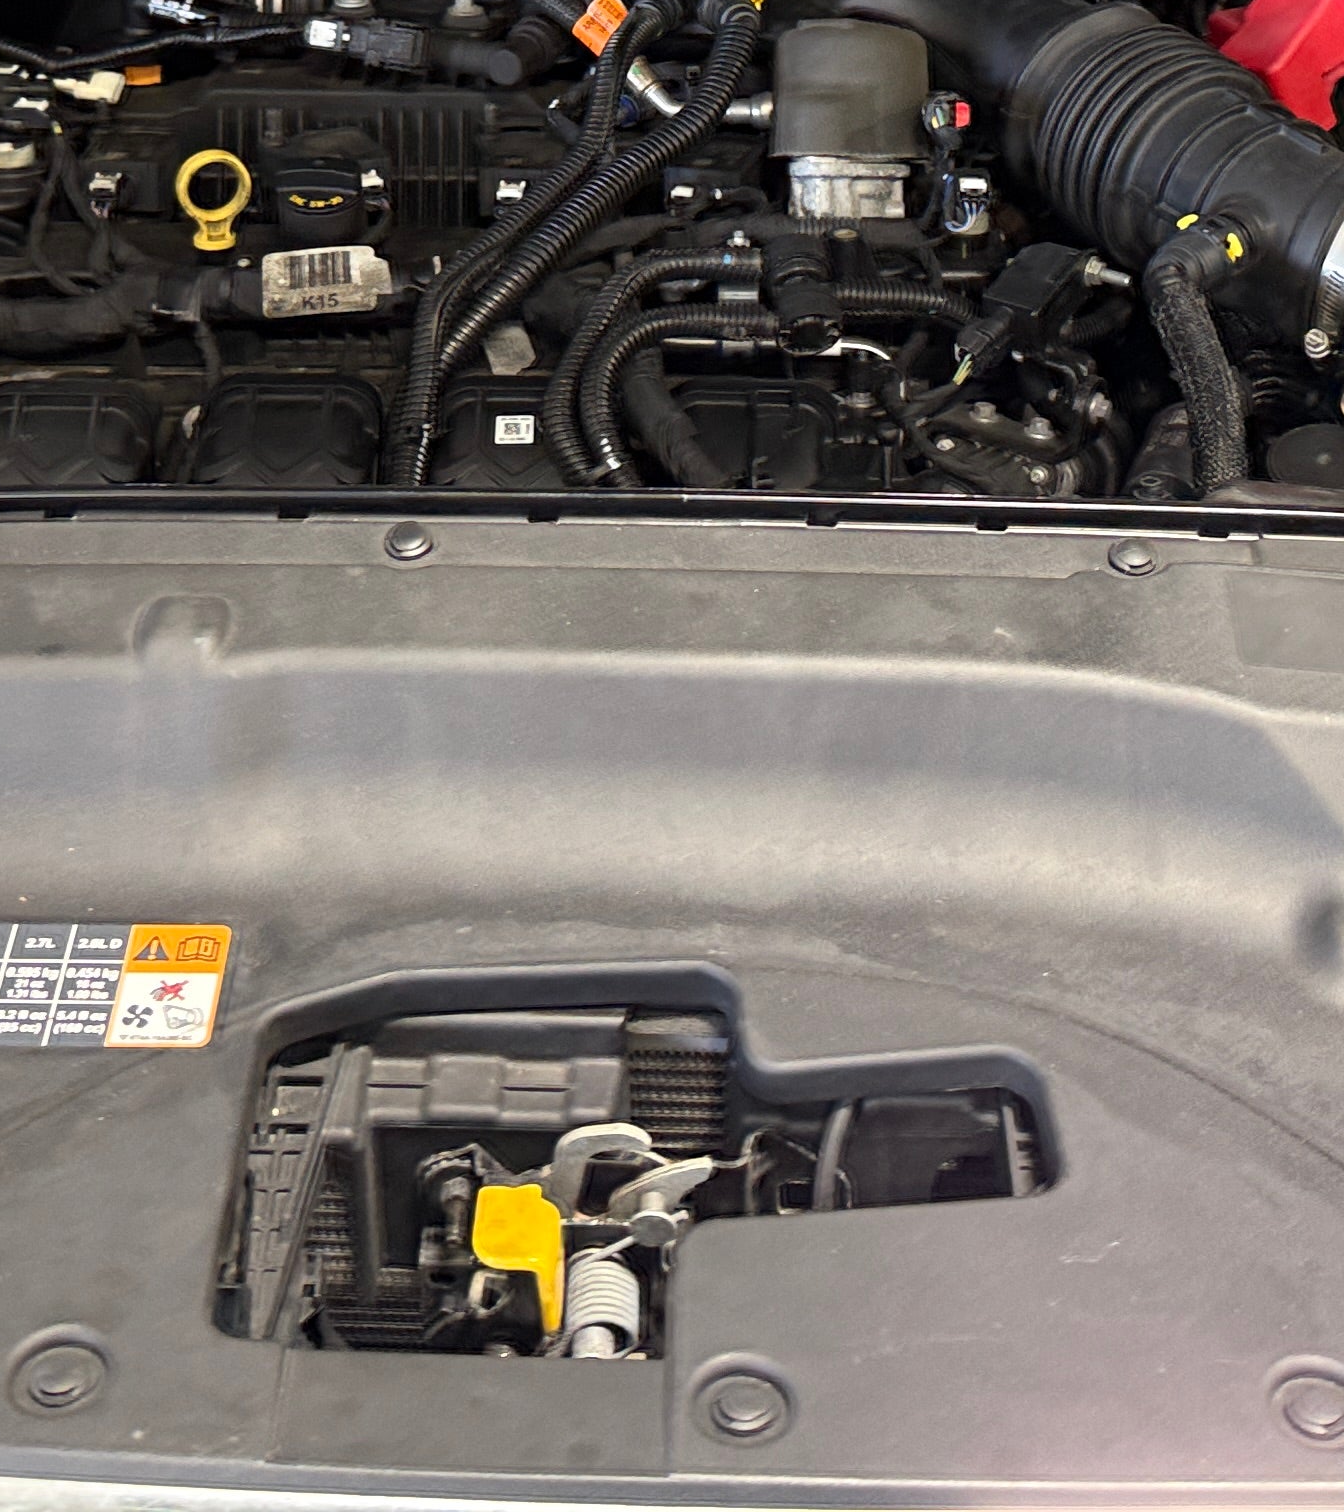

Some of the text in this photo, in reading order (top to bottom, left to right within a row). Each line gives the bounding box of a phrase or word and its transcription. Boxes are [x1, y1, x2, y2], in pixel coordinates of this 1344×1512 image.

[302, 293, 339, 310] K15
[24, 937, 56, 949] 2.7L
[42, 967, 60, 981] kg
[102, 968, 120, 982] kg
